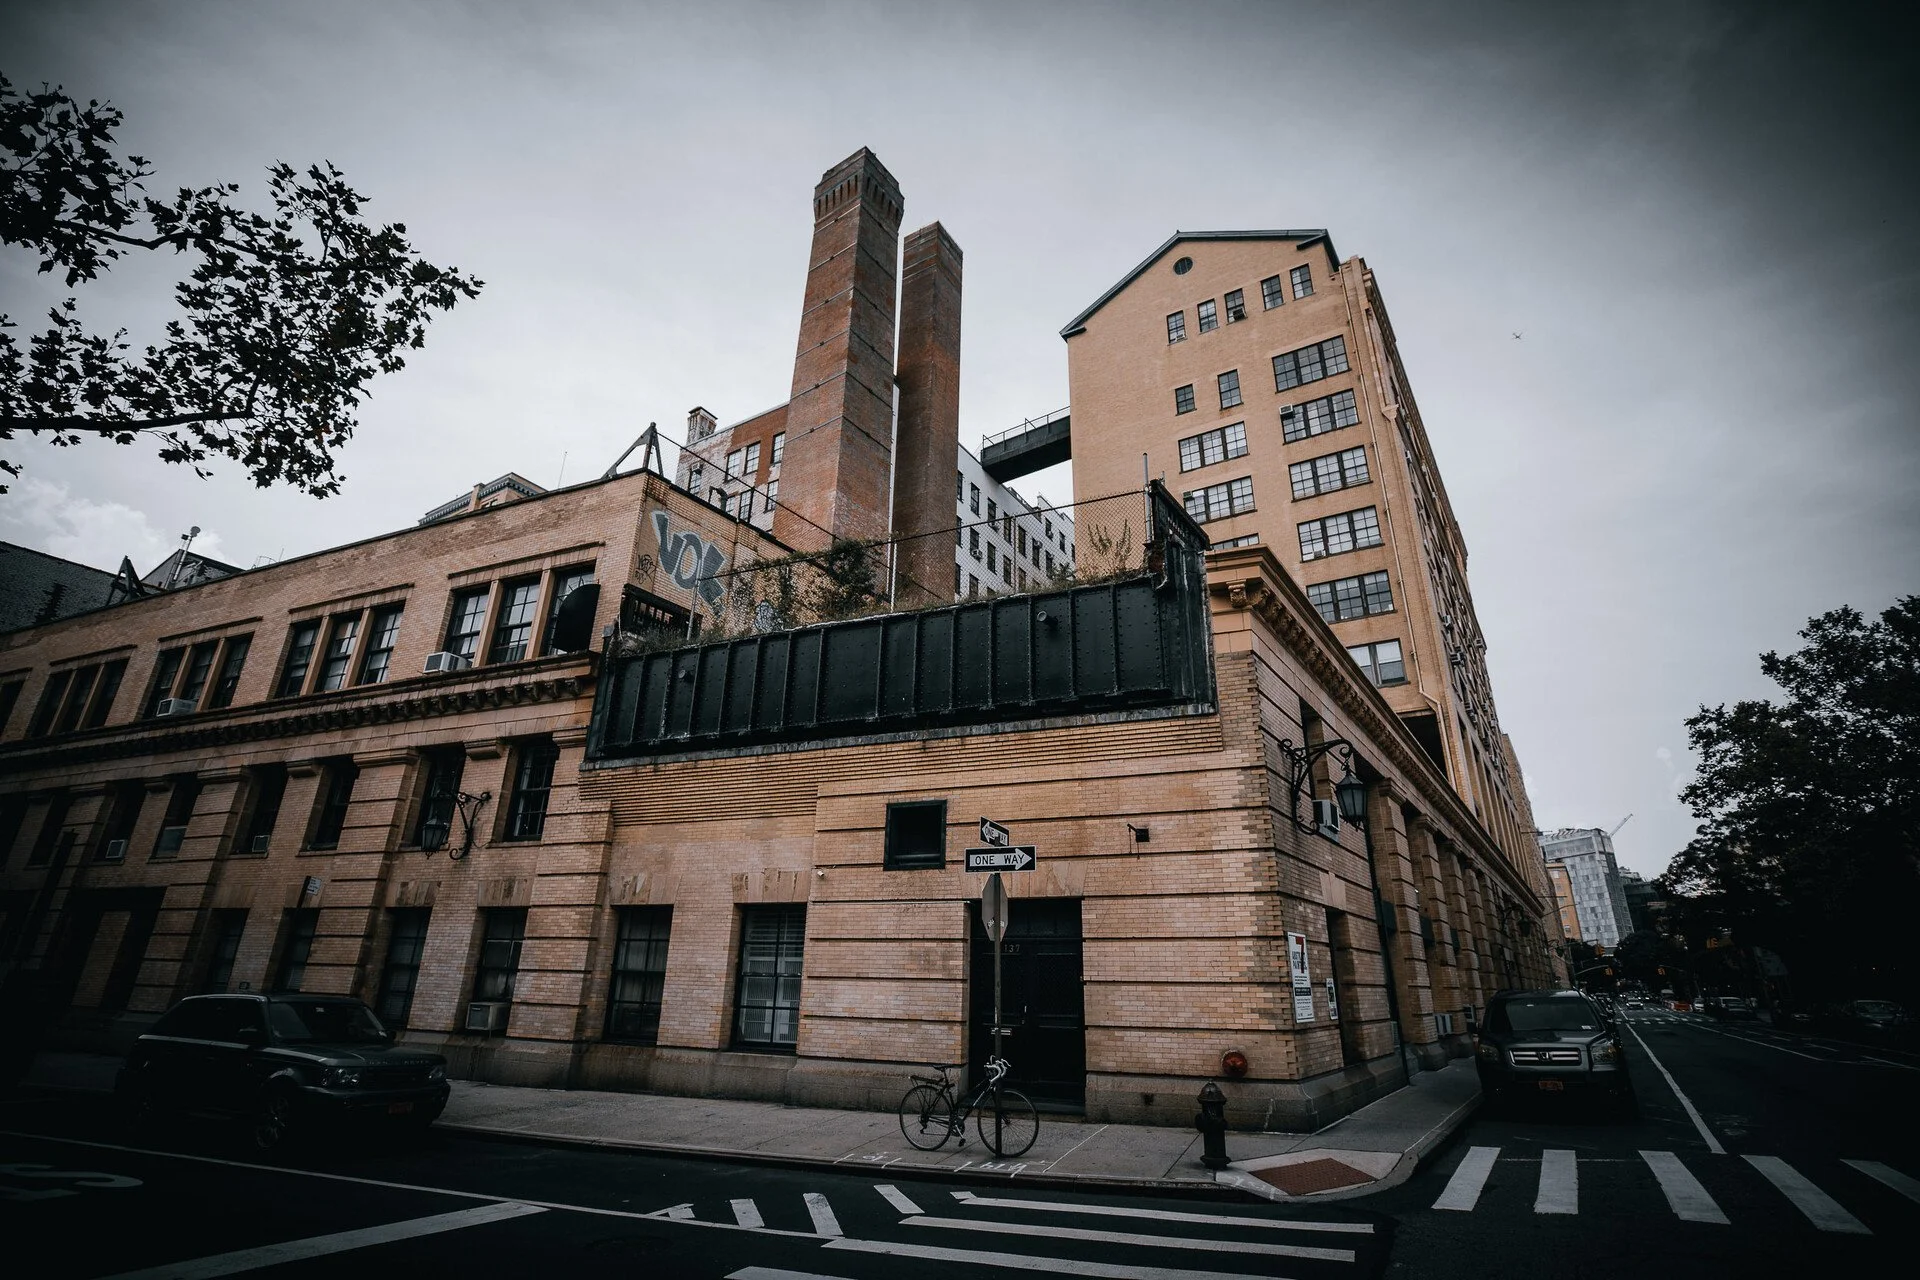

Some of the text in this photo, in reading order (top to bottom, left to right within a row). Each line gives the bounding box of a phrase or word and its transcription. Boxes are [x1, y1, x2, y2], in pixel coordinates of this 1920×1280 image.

[975, 853, 1025, 865] ONE WAY
[1004, 943, 1021, 953] 137
